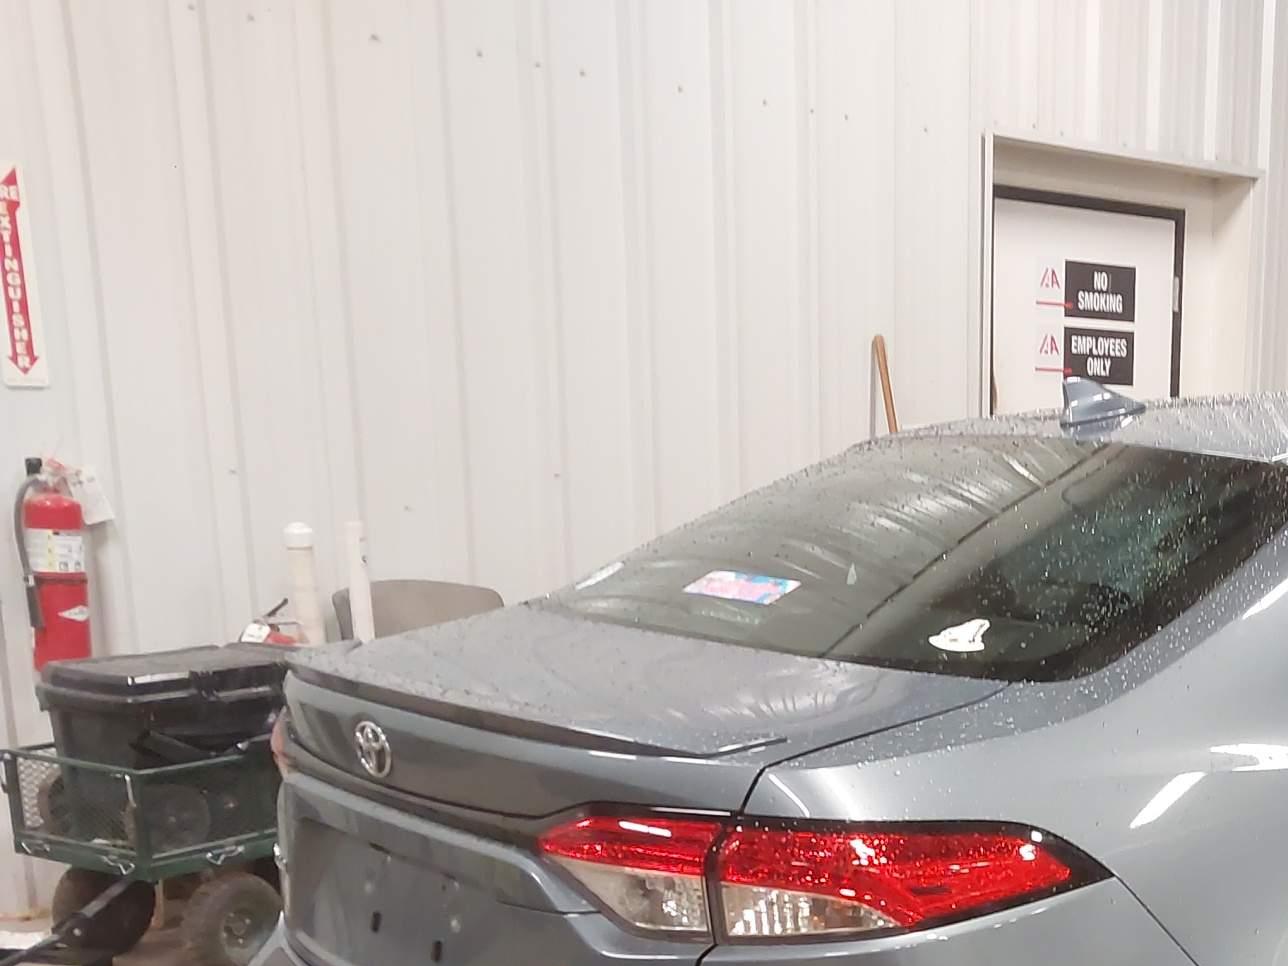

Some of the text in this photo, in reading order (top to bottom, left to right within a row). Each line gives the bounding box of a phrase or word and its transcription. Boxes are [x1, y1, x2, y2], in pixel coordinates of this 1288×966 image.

[1094, 271, 1108, 290] NO
[1078, 291, 1123, 313] SMOKING
[1072, 336, 1127, 357] EMPLOYEES
[1087, 358, 1111, 376] ONLY
